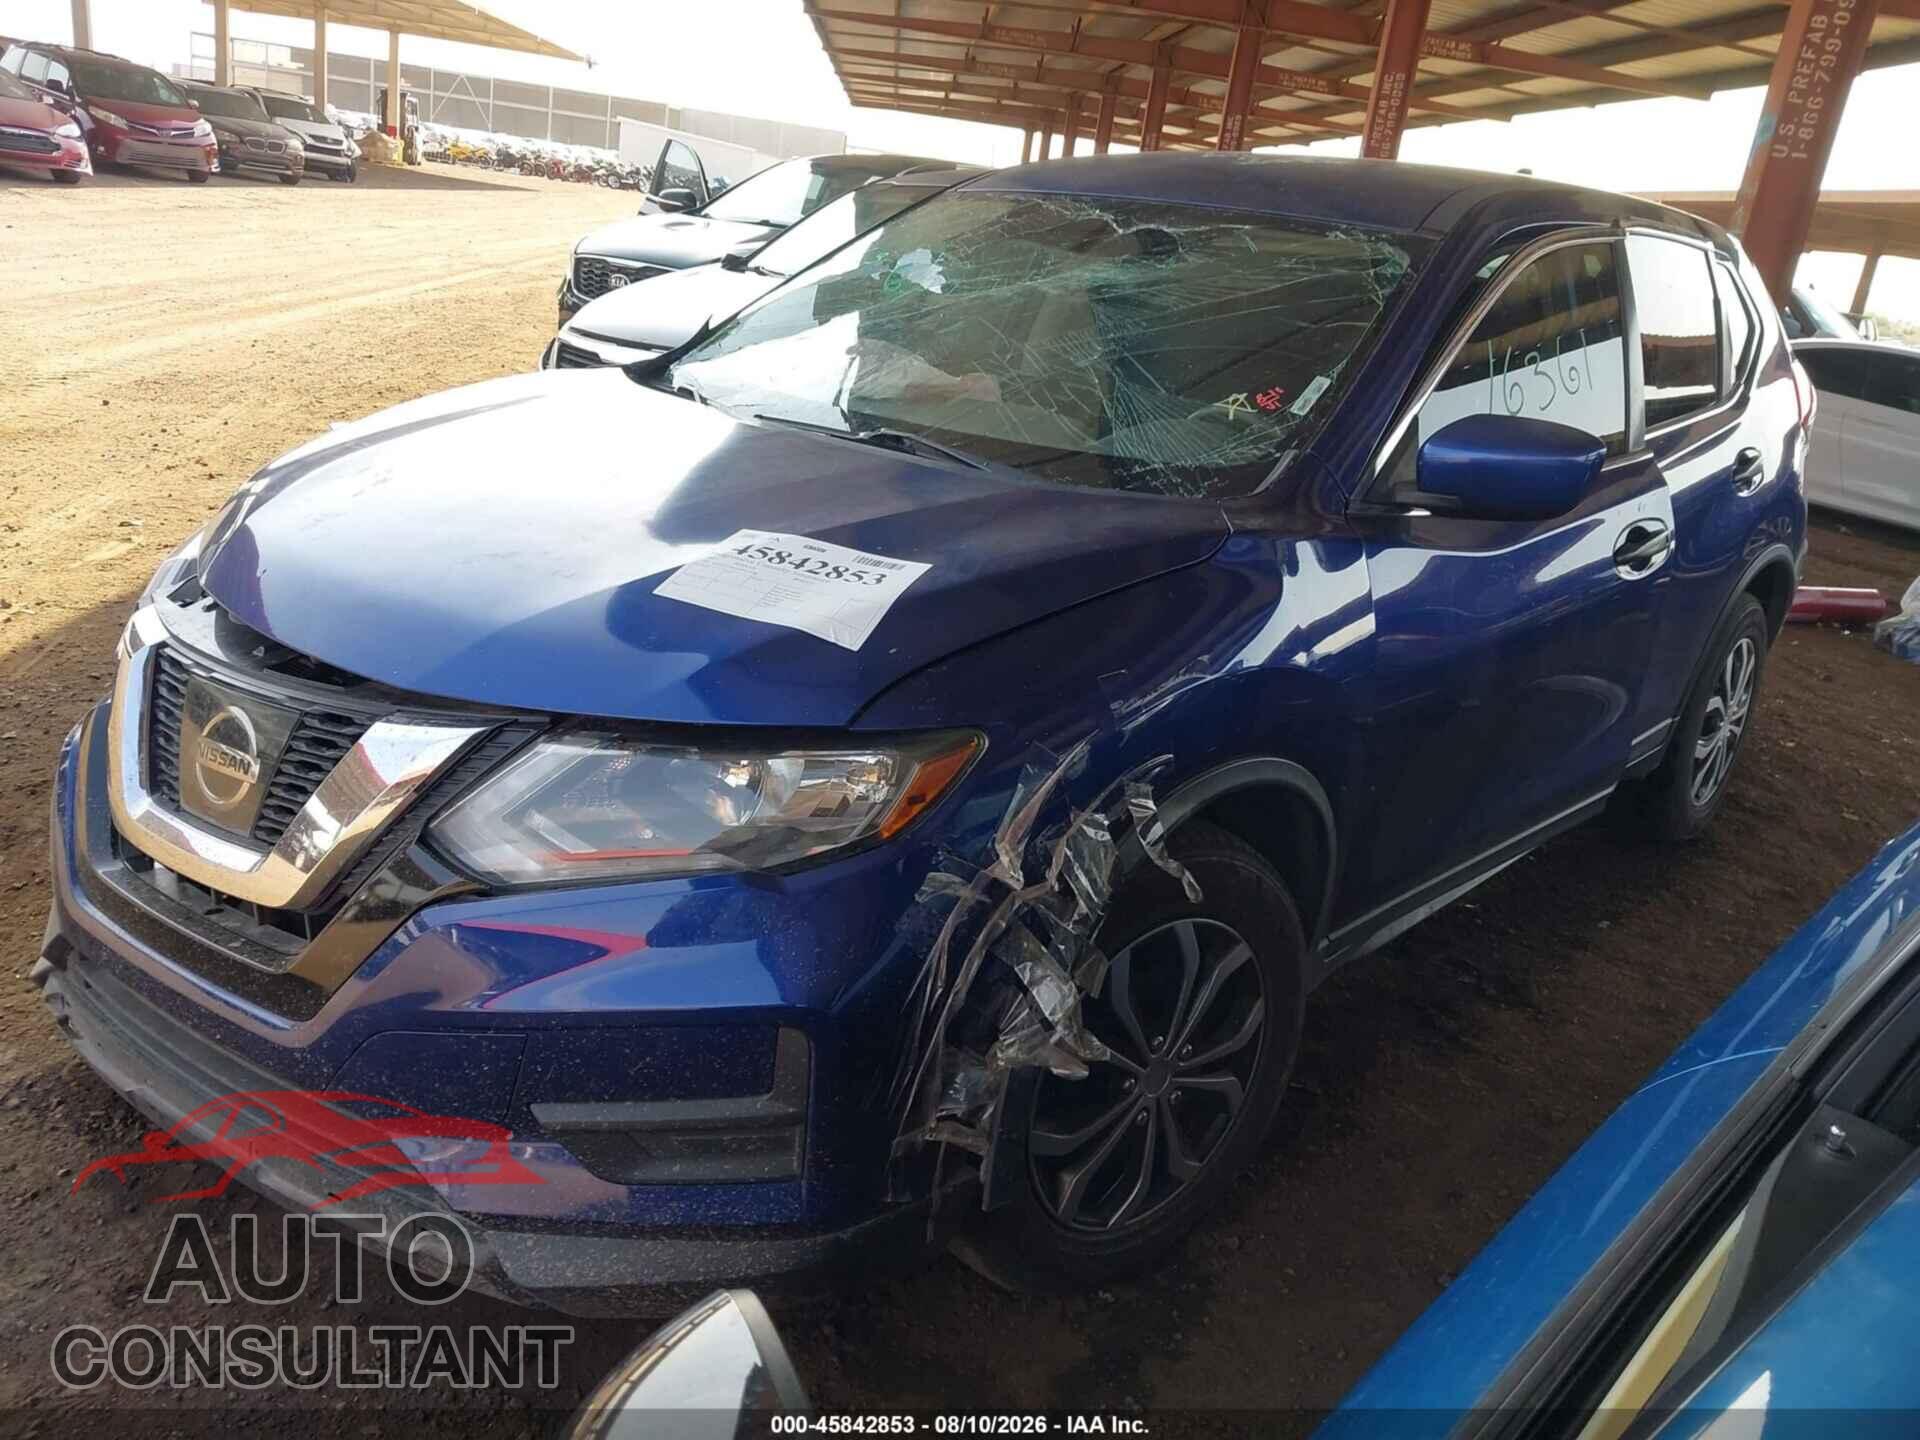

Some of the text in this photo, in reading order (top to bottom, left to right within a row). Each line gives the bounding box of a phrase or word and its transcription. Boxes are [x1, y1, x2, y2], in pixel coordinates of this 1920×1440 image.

[1772, 15, 1828, 158] U.S. PREFAB
[1487, 328, 1593, 416] 16361
[732, 543, 888, 586] 45842853
[200, 741, 252, 775] NISSAN
